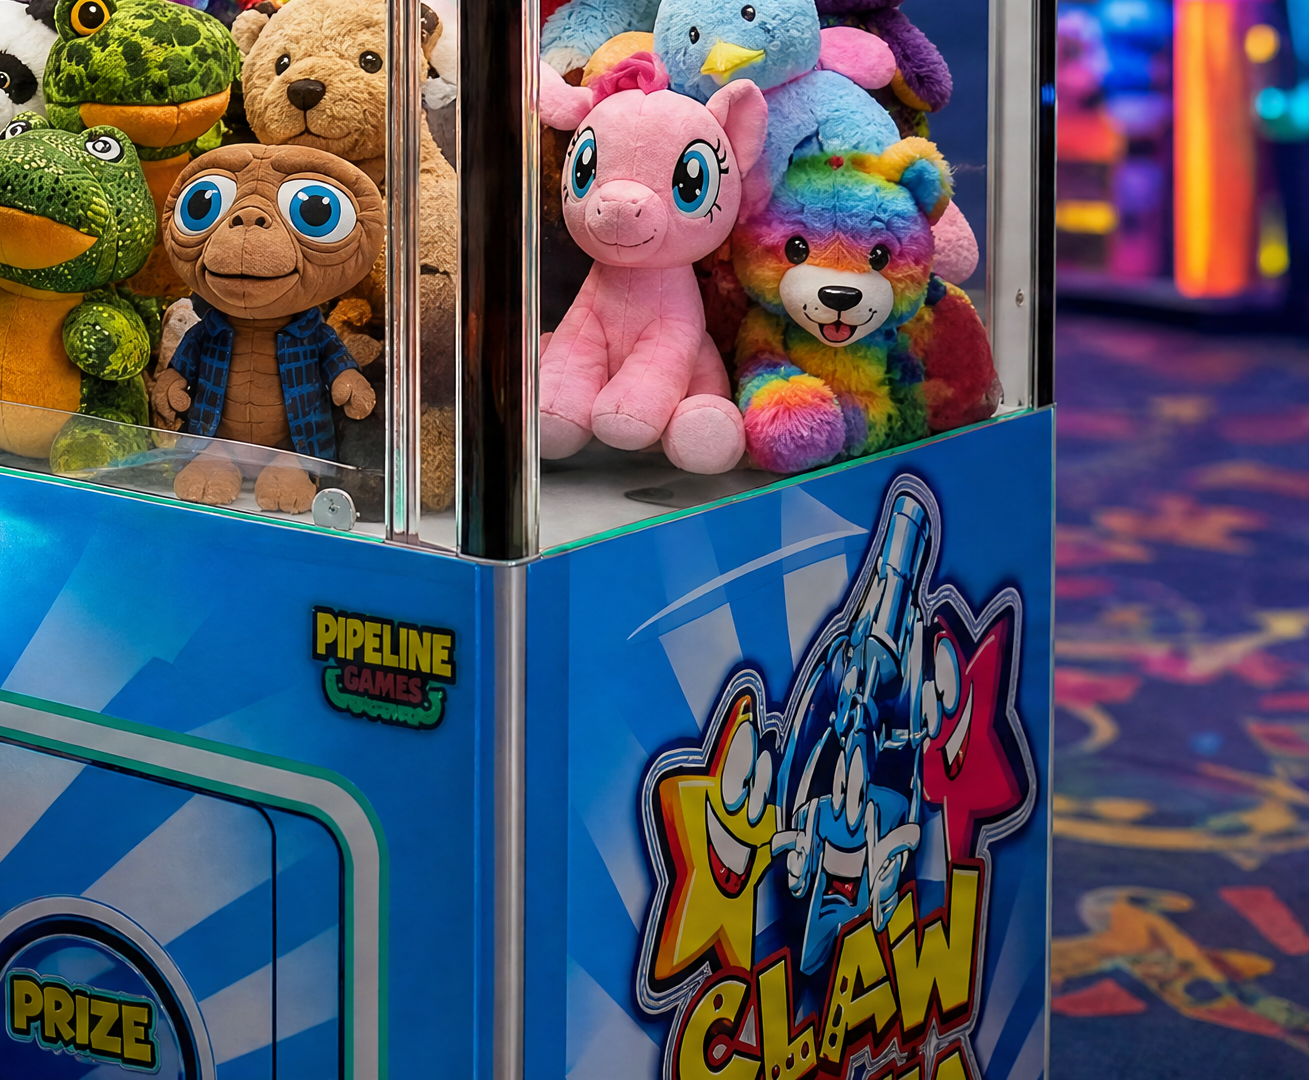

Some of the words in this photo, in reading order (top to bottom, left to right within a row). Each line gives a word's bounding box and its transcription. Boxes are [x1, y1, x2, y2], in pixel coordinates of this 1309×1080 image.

[317, 612, 451, 677] PIPELINE
[344, 665, 422, 703] GAMES
[677, 866, 979, 1080] CLAW
[14, 979, 151, 1062] PRIZE
